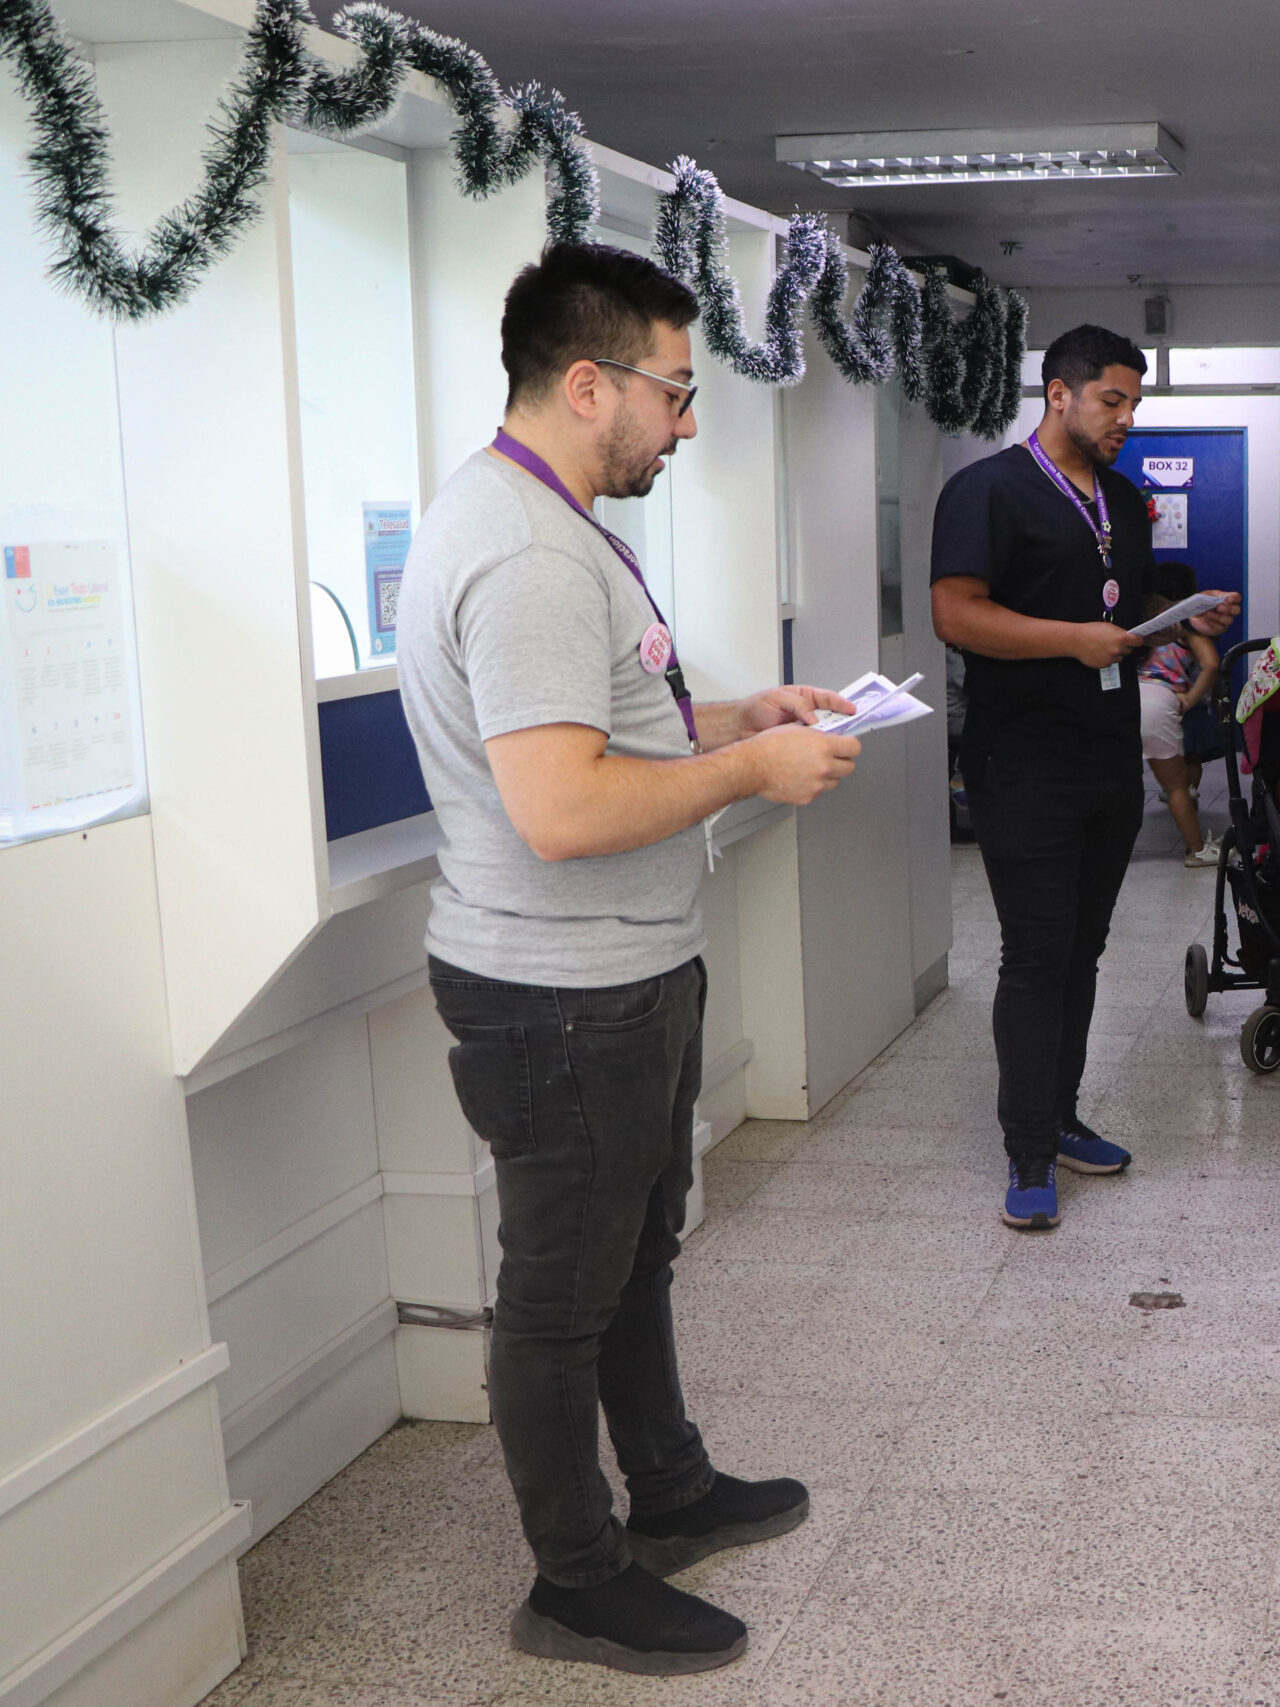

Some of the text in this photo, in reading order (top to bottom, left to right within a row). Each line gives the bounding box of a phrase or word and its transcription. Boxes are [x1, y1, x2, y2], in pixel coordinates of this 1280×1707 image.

[1032, 441, 1059, 473] Corporación
[1149, 461, 1188, 471] BOX 32
[379, 520, 409, 529] Telesalud
